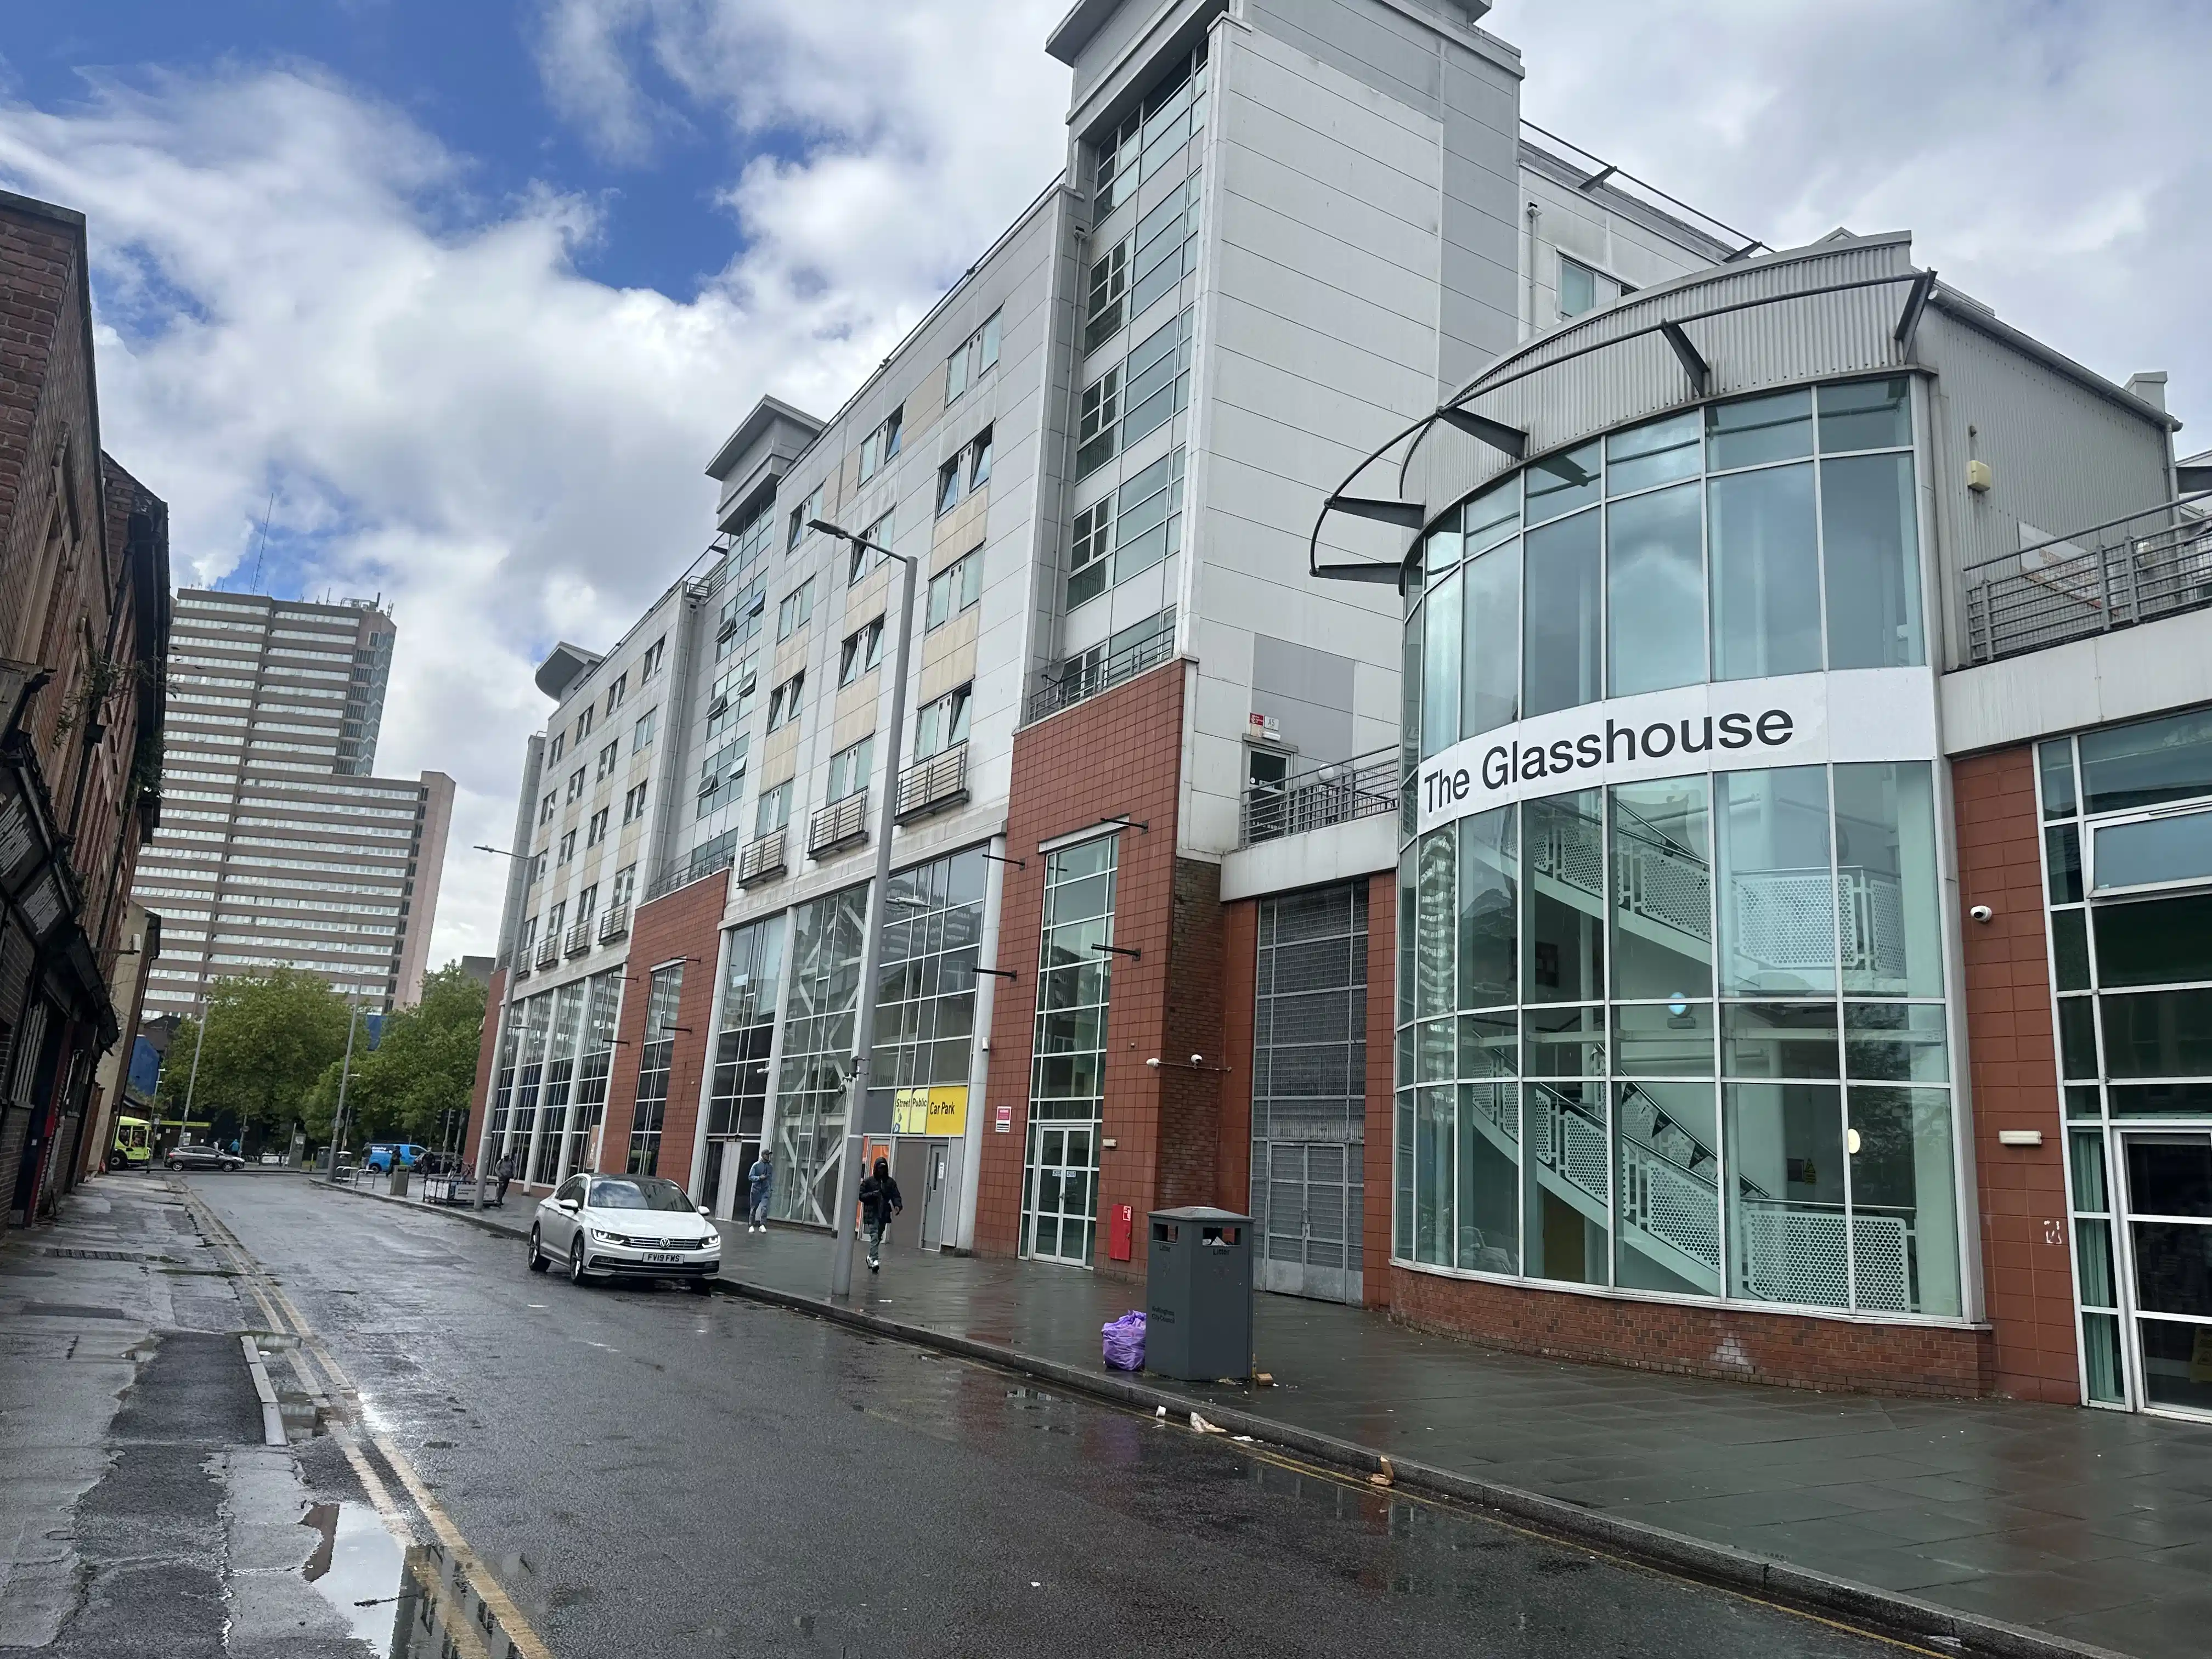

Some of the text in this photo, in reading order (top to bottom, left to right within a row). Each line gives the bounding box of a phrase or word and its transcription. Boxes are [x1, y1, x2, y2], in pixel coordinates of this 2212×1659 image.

[1424, 709, 1793, 813] The Glasshouse
[896, 1098, 955, 1115] Street Public Car Park
